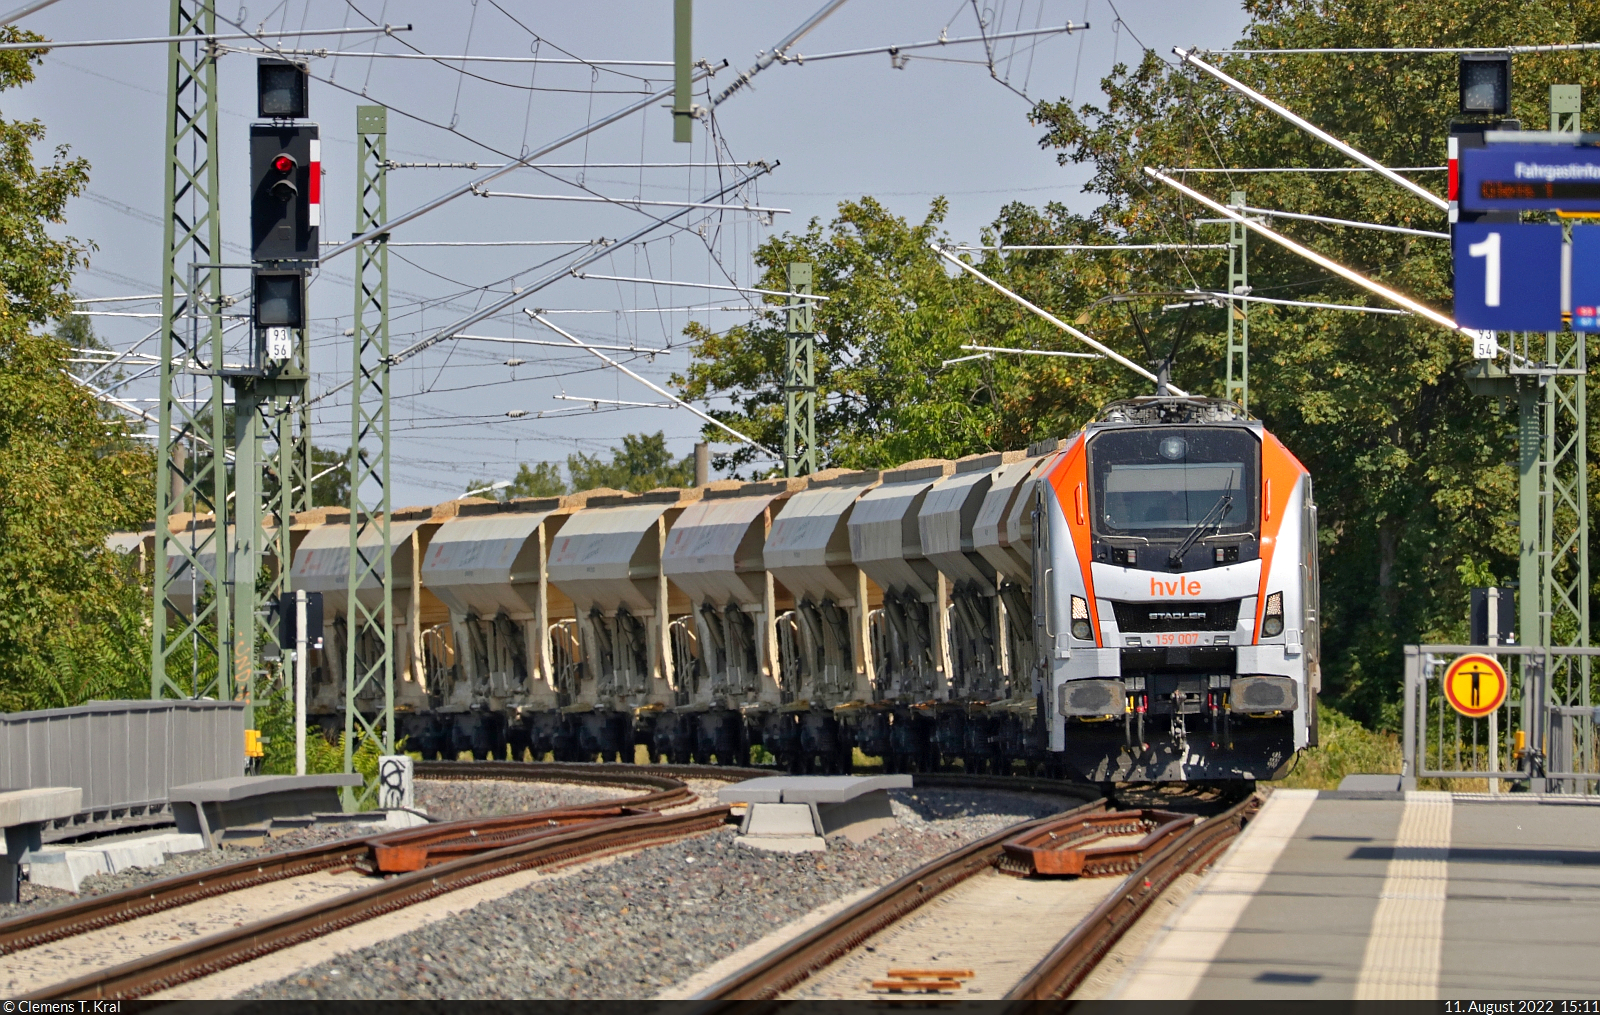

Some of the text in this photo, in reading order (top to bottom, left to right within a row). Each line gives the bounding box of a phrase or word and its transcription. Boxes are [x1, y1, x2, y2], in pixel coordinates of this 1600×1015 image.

[1468, 232, 1500, 307] 1
[273, 329, 286, 341] 93
[273, 344, 287, 356] 56
[1479, 343, 1492, 355] 54
[1150, 575, 1201, 596] hvle
[1148, 612, 1206, 620] STADLER
[1156, 633, 1199, 645] 159 007
